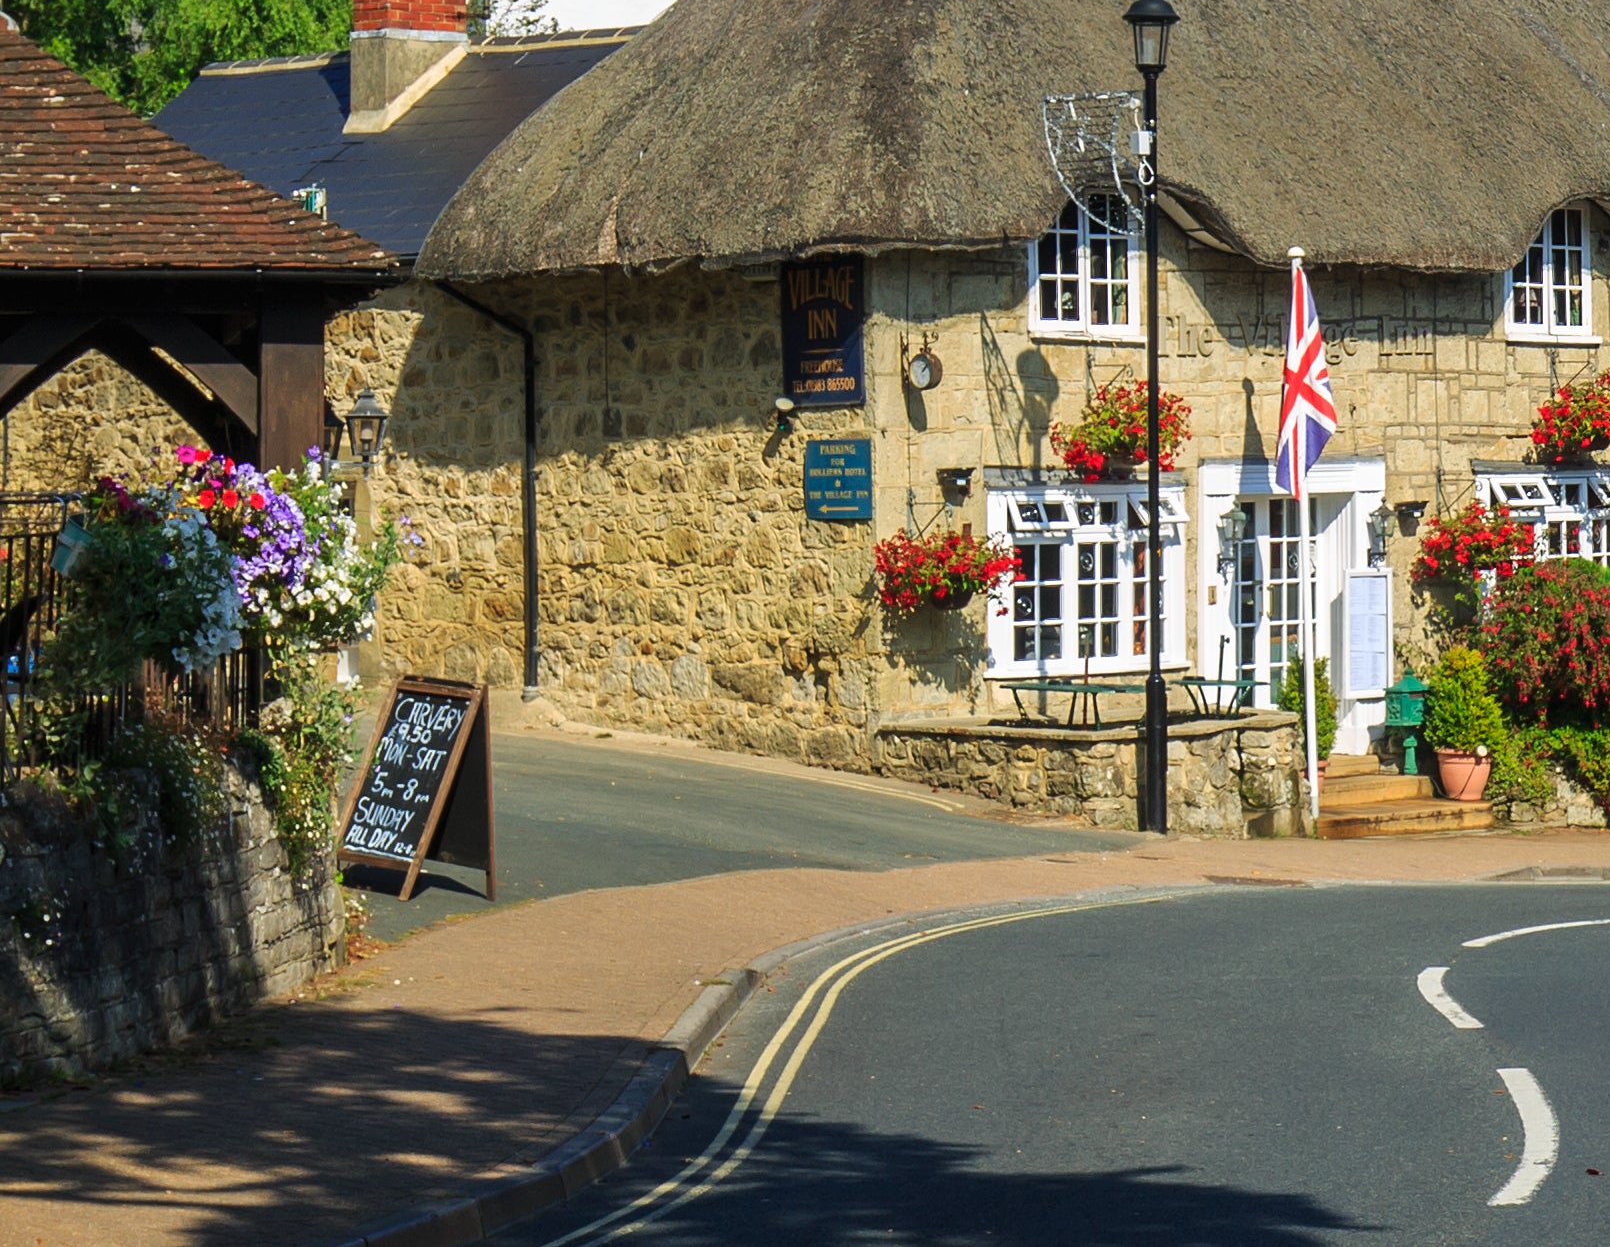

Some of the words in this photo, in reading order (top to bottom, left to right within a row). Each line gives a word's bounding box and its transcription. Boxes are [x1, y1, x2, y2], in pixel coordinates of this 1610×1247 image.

[788, 266, 855, 311] VILLAGE
[808, 308, 837, 340] INN
[1157, 314, 1215, 358] The
[1237, 313, 1359, 365] Vilge
[1379, 315, 1433, 356] Inn
[820, 444, 856, 455] PARKING
[831, 458, 845, 466] FOR
[844, 468, 866, 476] HOTEL
[395, 697, 467, 741] CARVERY
[353, 796, 416, 832] SUNDAY
[345, 824, 366, 845] ALL
[368, 827, 398, 850] DAY
